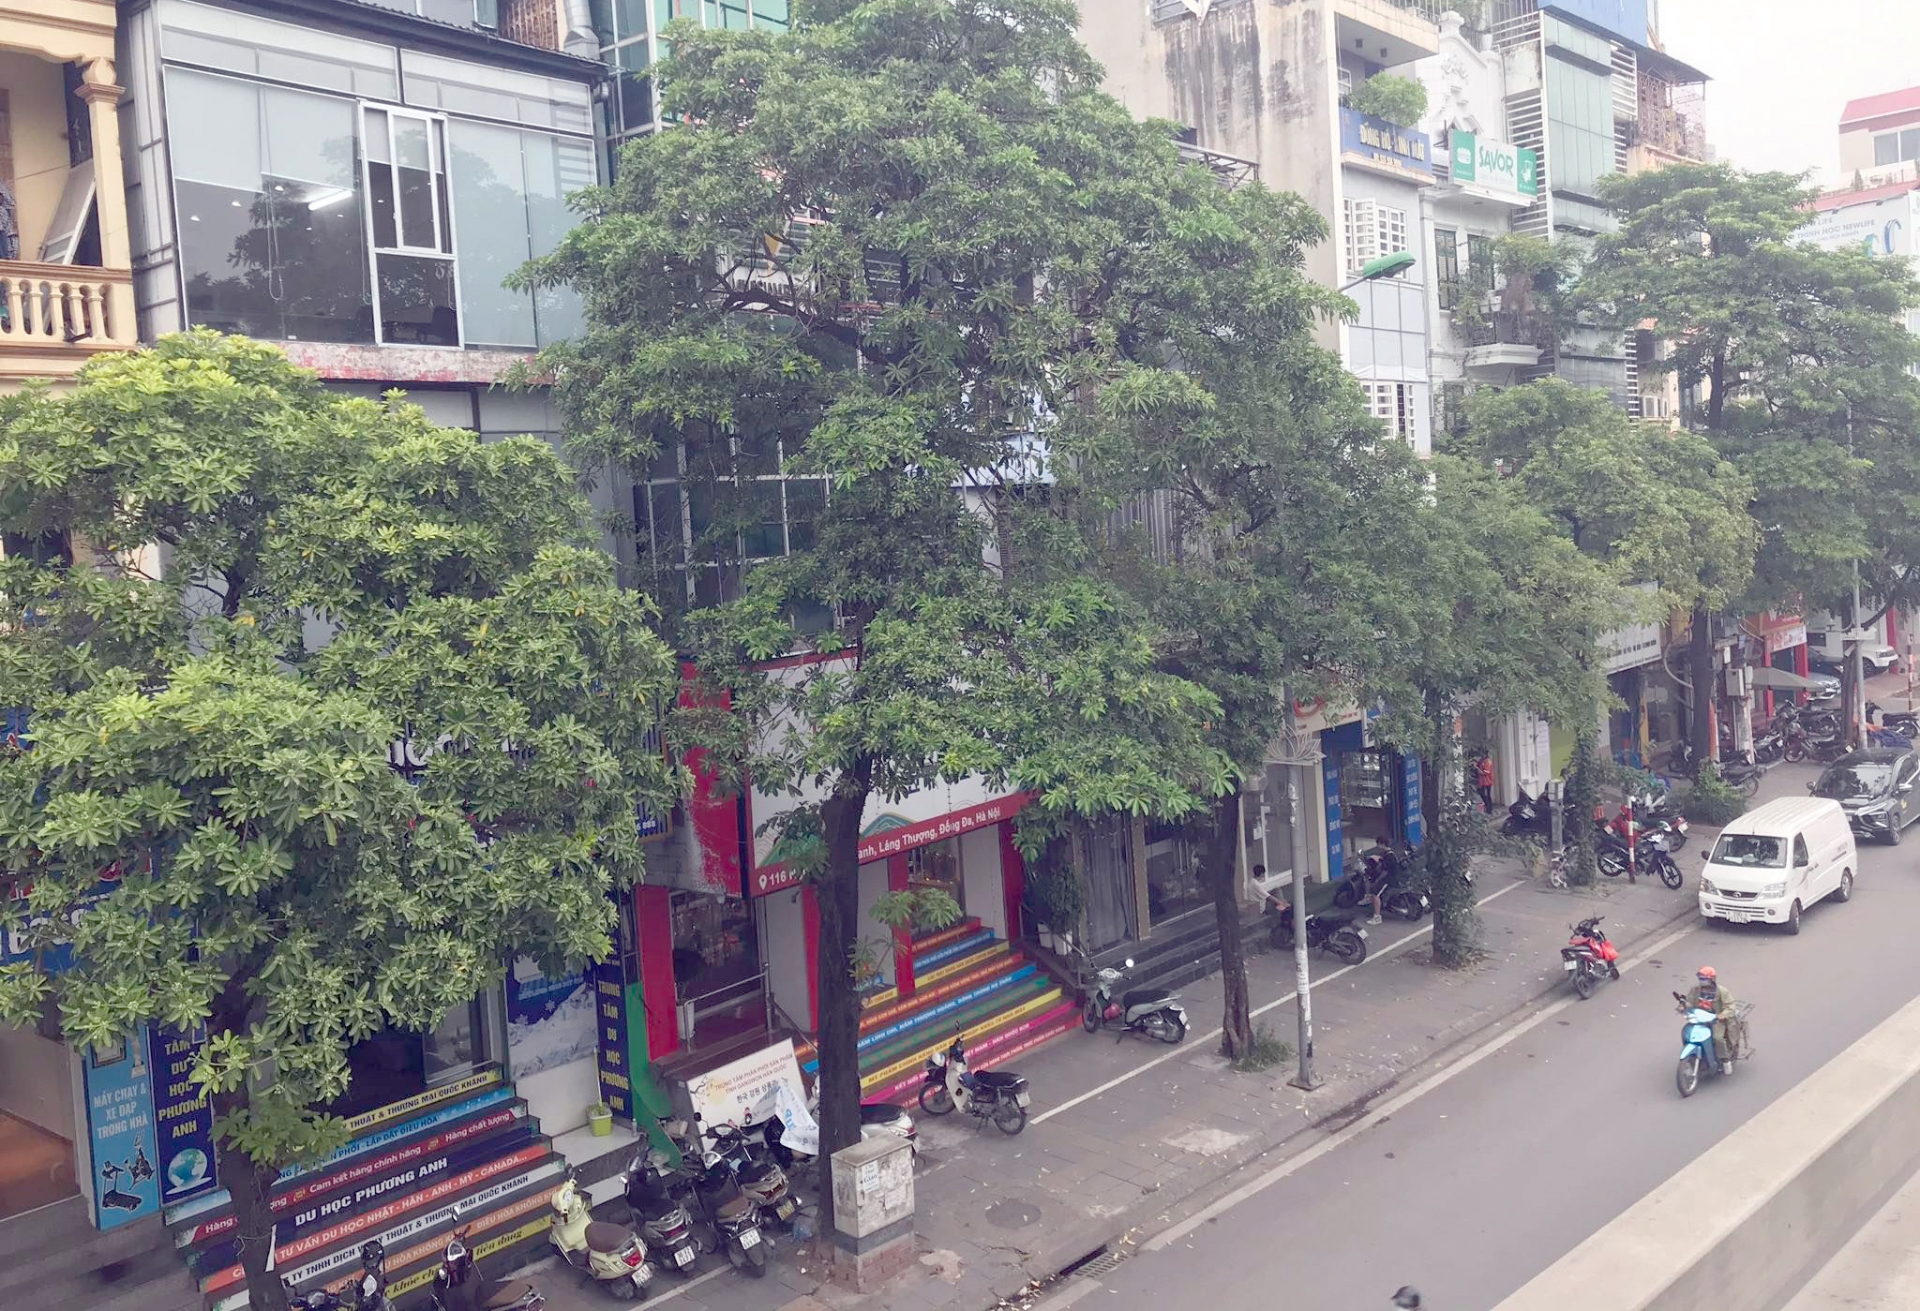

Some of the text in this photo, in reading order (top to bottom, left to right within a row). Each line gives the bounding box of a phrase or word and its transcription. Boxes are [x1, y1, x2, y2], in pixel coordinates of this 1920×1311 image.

[1479, 145, 1514, 178] SAVOR
[1843, 219, 1876, 231] NEWLIFE
[769, 870, 787, 887] 116
[902, 828, 938, 848] Thượng,
[962, 815, 976, 830] Đa,
[976, 810, 987, 824] Hà
[607, 1027, 617, 1042] DU
[732, 1075, 744, 1086] TÂM
[737, 1076, 763, 1091] GANGWON
[94, 1082, 147, 1108] MÁY CHẠY &
[106, 1100, 137, 1121] XE ĐẠP
[158, 1096, 207, 1122] PHƯƠNG
[378, 1110, 385, 1119] &
[97, 1111, 148, 1140] TRONG NHÀ
[173, 1120, 197, 1139] ANH
[205, 1218, 234, 1235] Hàng
[309, 1180, 331, 1194] Cam
[332, 1172, 349, 1185] kết
[348, 1164, 373, 1179] hàng
[373, 1154, 399, 1170] chính
[445, 1127, 468, 1143] Hàng
[467, 1119, 488, 1134] chất
[294, 1156, 448, 1227] DU HỌC PHƯƠNG ANH
[279, 1246, 295, 1260] TƯ
[296, 1235, 320, 1252] VẤN
[322, 1230, 337, 1242] DU
[339, 1219, 364, 1236] HỌC
[366, 1206, 395, 1222] NHẬT
[431, 1183, 452, 1198] ANH
[459, 1172, 474, 1187] MỸ
[480, 1155, 528, 1177] CANADA...
[291, 1270, 303, 1282] TY
[305, 1257, 331, 1275] TNHH
[333, 1246, 356, 1264] DỊCH
[386, 1222, 414, 1241] THUẬT
[415, 1219, 422, 1229] &
[459, 1196, 477, 1210] MẠI
[478, 1186, 501, 1203] QUỐC
[500, 1175, 529, 1192] KHÁNH
[394, 1252, 412, 1267] HÒA
[413, 1236, 444, 1257] KHÔNG
